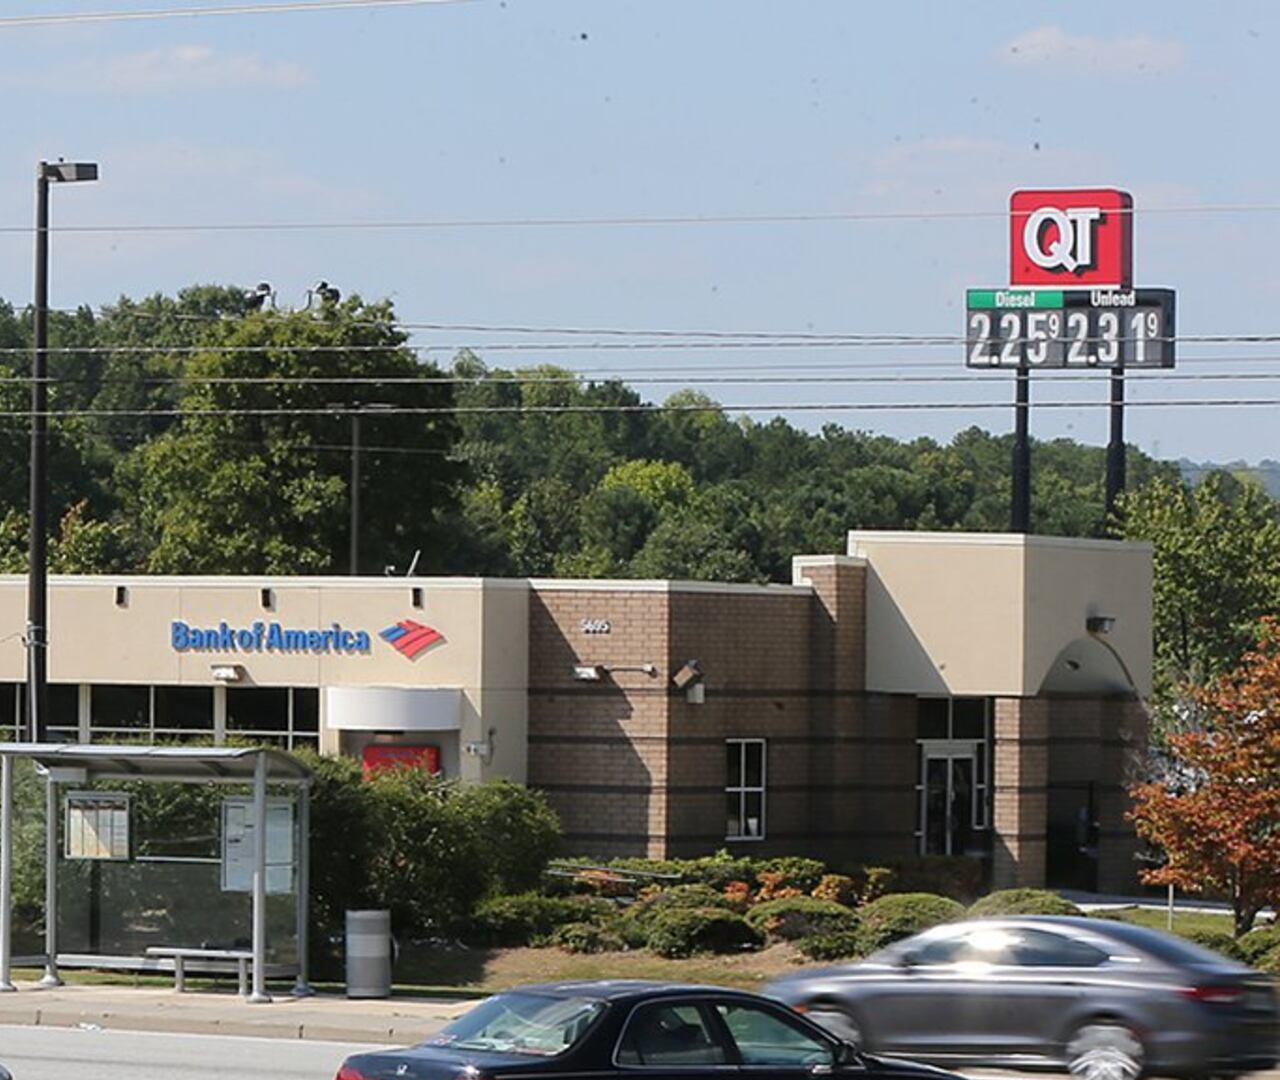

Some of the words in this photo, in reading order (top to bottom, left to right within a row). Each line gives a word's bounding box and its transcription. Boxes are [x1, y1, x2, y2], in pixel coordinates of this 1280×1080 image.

[1024, 206, 1101, 272] QT
[995, 291, 1036, 308] Diesel
[1090, 289, 1137, 308] Unlead
[170, 621, 237, 651] Bank
[238, 621, 265, 651] of
[266, 622, 371, 652] America
